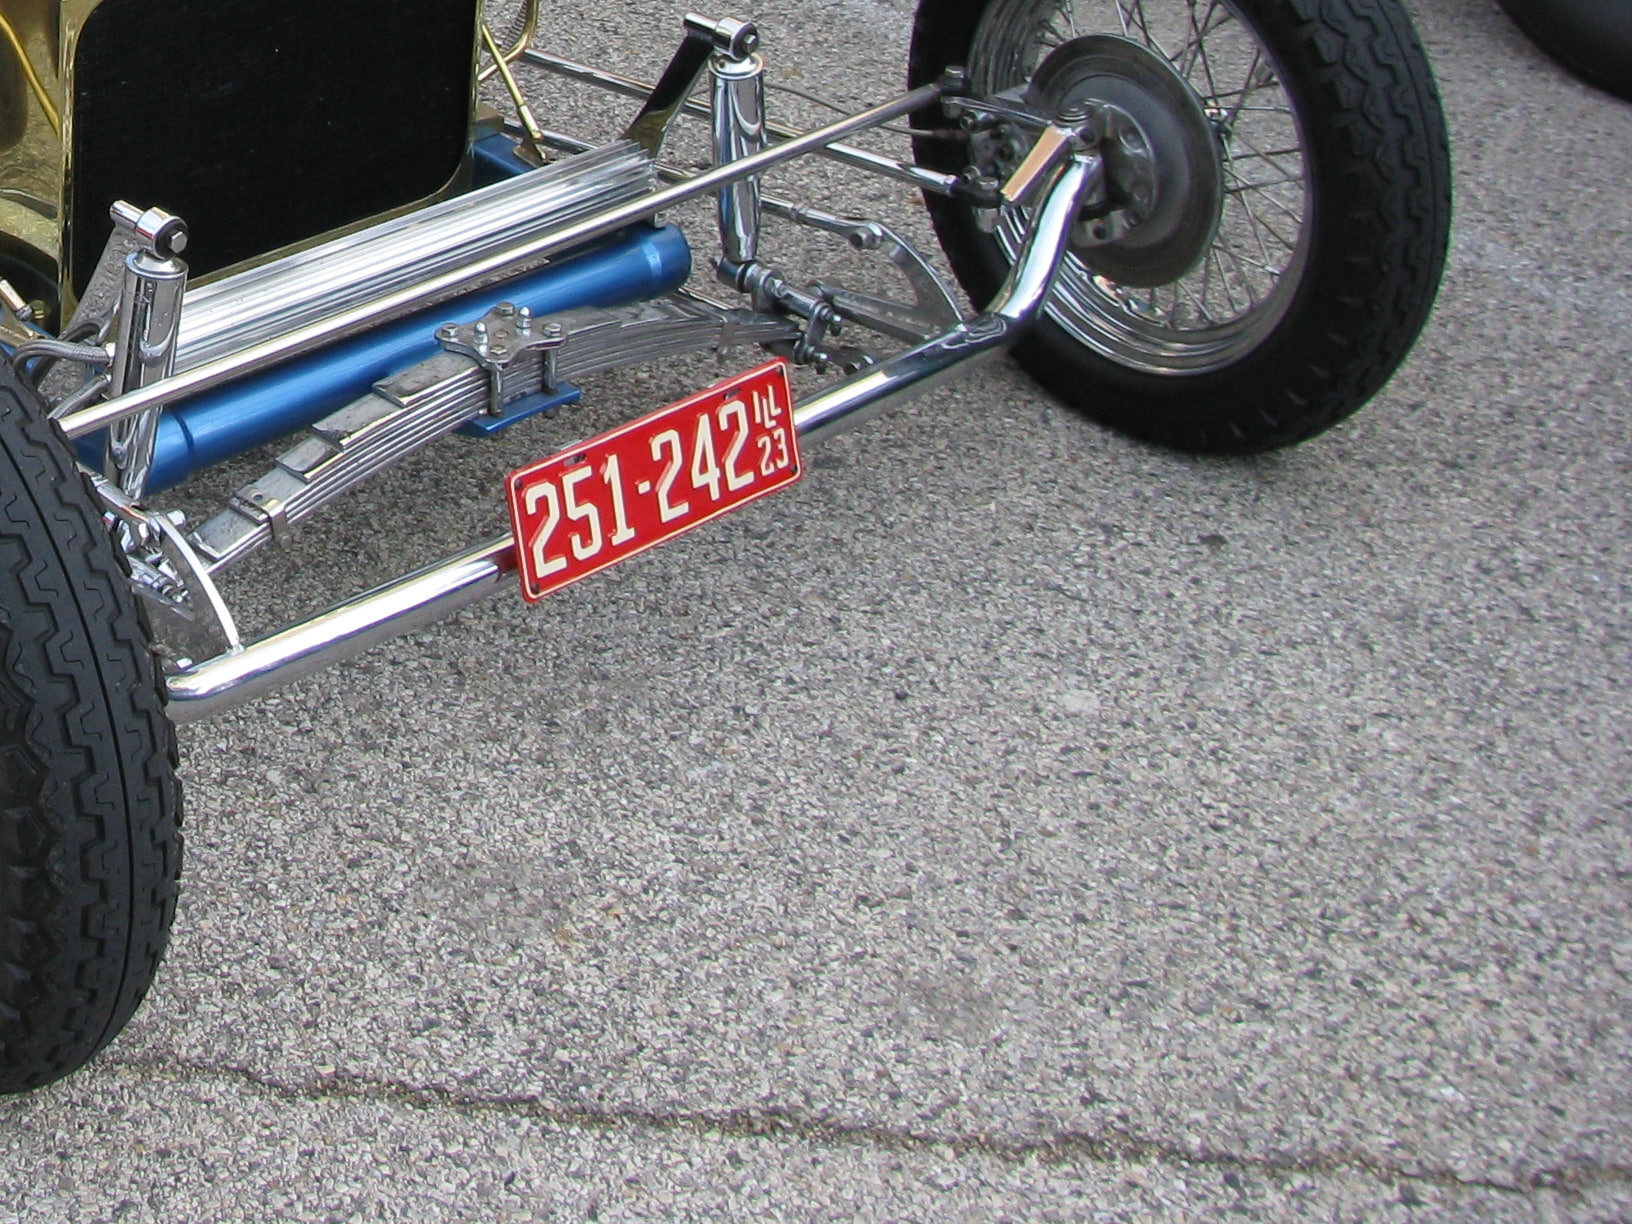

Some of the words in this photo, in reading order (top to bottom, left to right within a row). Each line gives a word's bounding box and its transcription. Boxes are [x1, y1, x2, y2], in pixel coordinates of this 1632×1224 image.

[525, 400, 755, 578] 251-242
[752, 384, 781, 429] ILL
[757, 428, 790, 477] 23
